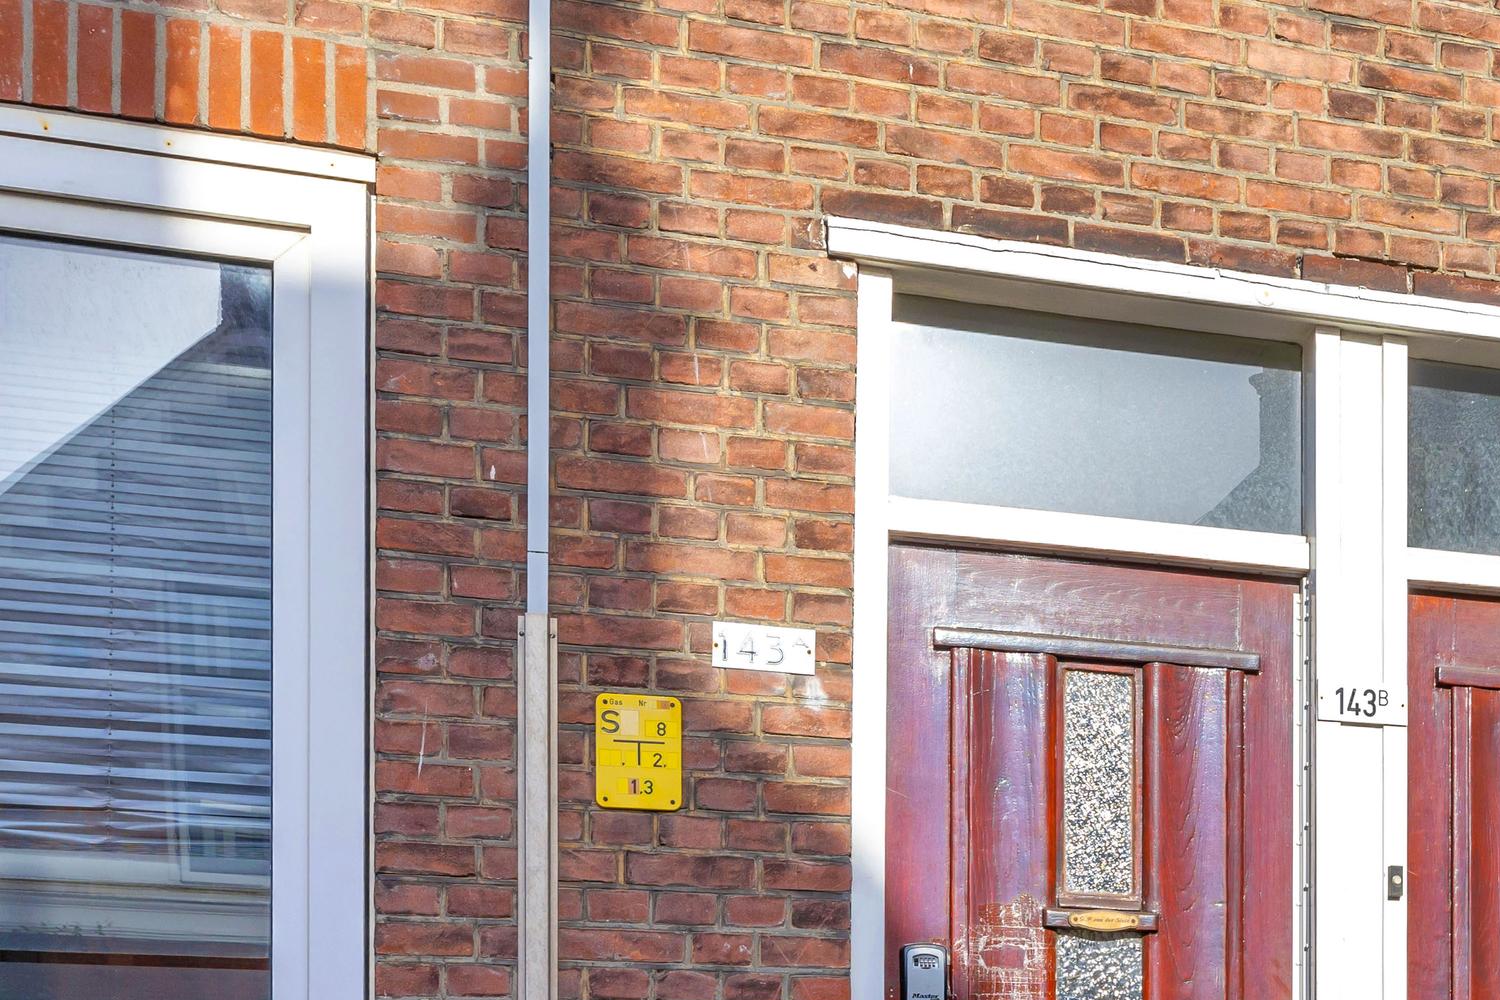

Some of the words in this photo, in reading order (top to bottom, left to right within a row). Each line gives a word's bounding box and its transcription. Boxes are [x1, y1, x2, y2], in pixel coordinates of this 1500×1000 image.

[608, 698, 623, 706] Gas
[638, 699, 647, 707] Nr
[601, 709, 620, 734] S
[657, 721, 666, 737] 8
